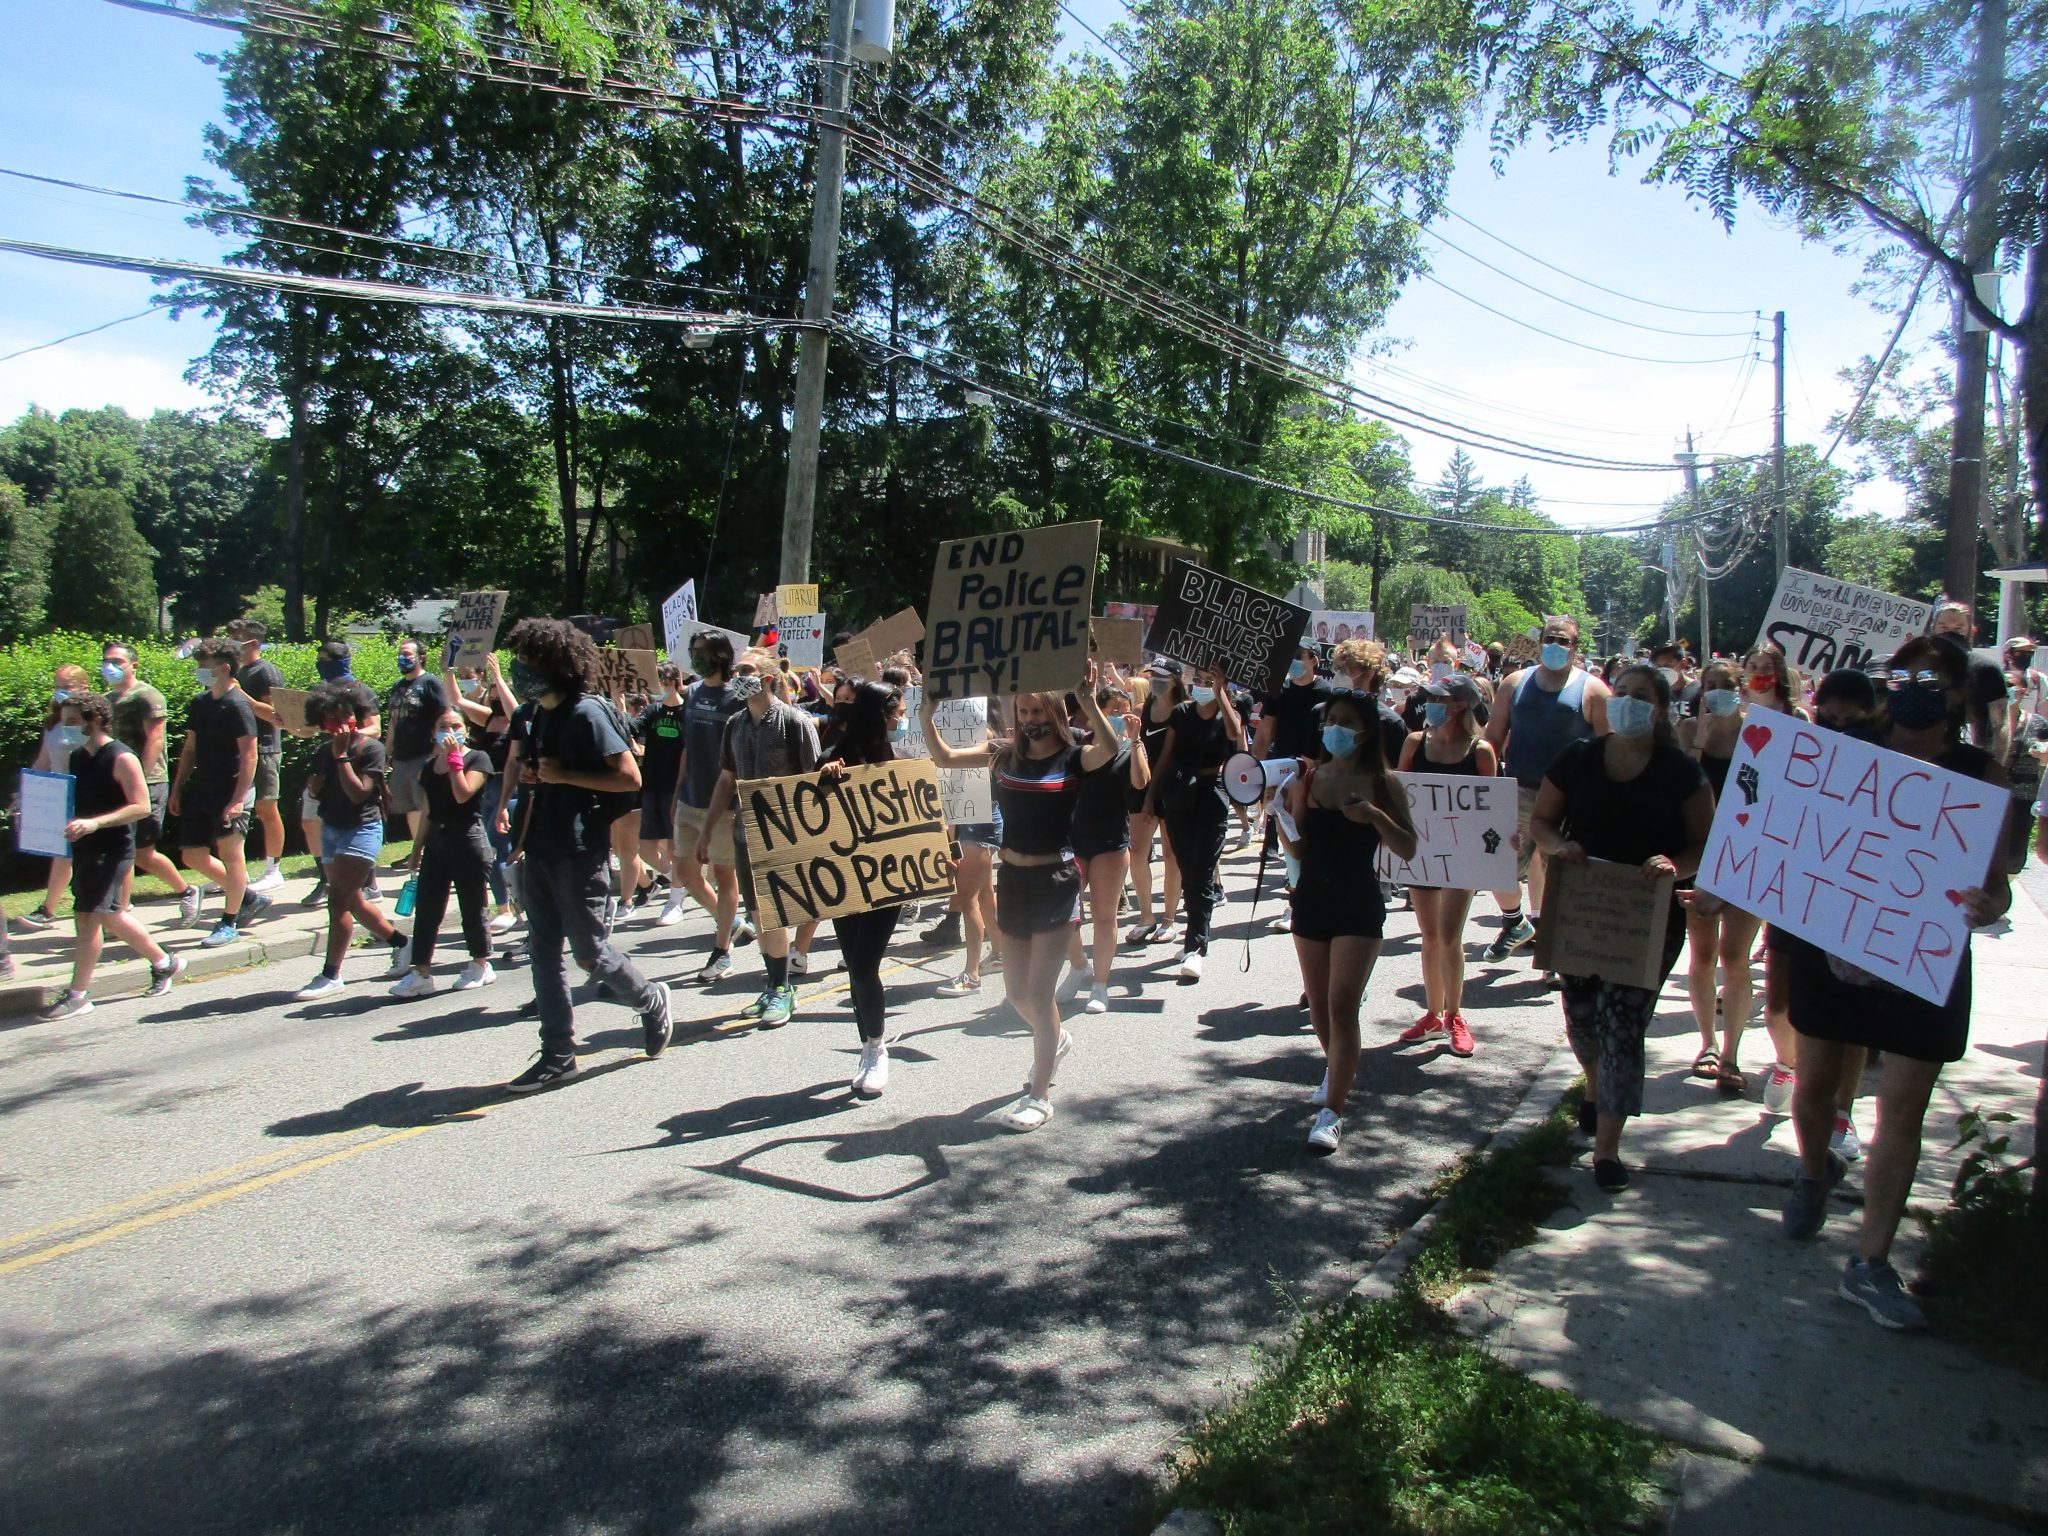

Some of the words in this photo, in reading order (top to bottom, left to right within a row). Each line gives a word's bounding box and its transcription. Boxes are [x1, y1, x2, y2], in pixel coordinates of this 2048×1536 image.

[948, 533, 1024, 570] END
[459, 593, 498, 609] BLACK
[663, 592, 686, 618] BLACK
[958, 565, 1086, 611] Police
[1179, 570, 1293, 638] BLACK
[1784, 572, 1808, 593] I
[1853, 590, 1926, 627] NEVER
[450, 618, 493, 633] MATTER
[465, 607, 494, 619] LIVES
[668, 610, 687, 634] LIVES
[778, 615, 814, 629] RESPECT
[1411, 614, 1466, 628] JUSTICE
[1806, 616, 1842, 636] BUT
[777, 629, 811, 642] PROTECT
[932, 610, 1088, 668] BRUTAL-
[1186, 607, 1274, 664] LIVES
[929, 656, 1020, 699] ITY!
[1163, 628, 1271, 693] MATTER
[957, 714, 983, 728] YOU
[1404, 782, 1492, 812] STICE
[1784, 731, 1981, 853] BLACK
[751, 780, 831, 851] NO
[1761, 795, 1938, 899] LIVES
[766, 856, 847, 926] NO
[1714, 835, 1952, 995] MATTER
